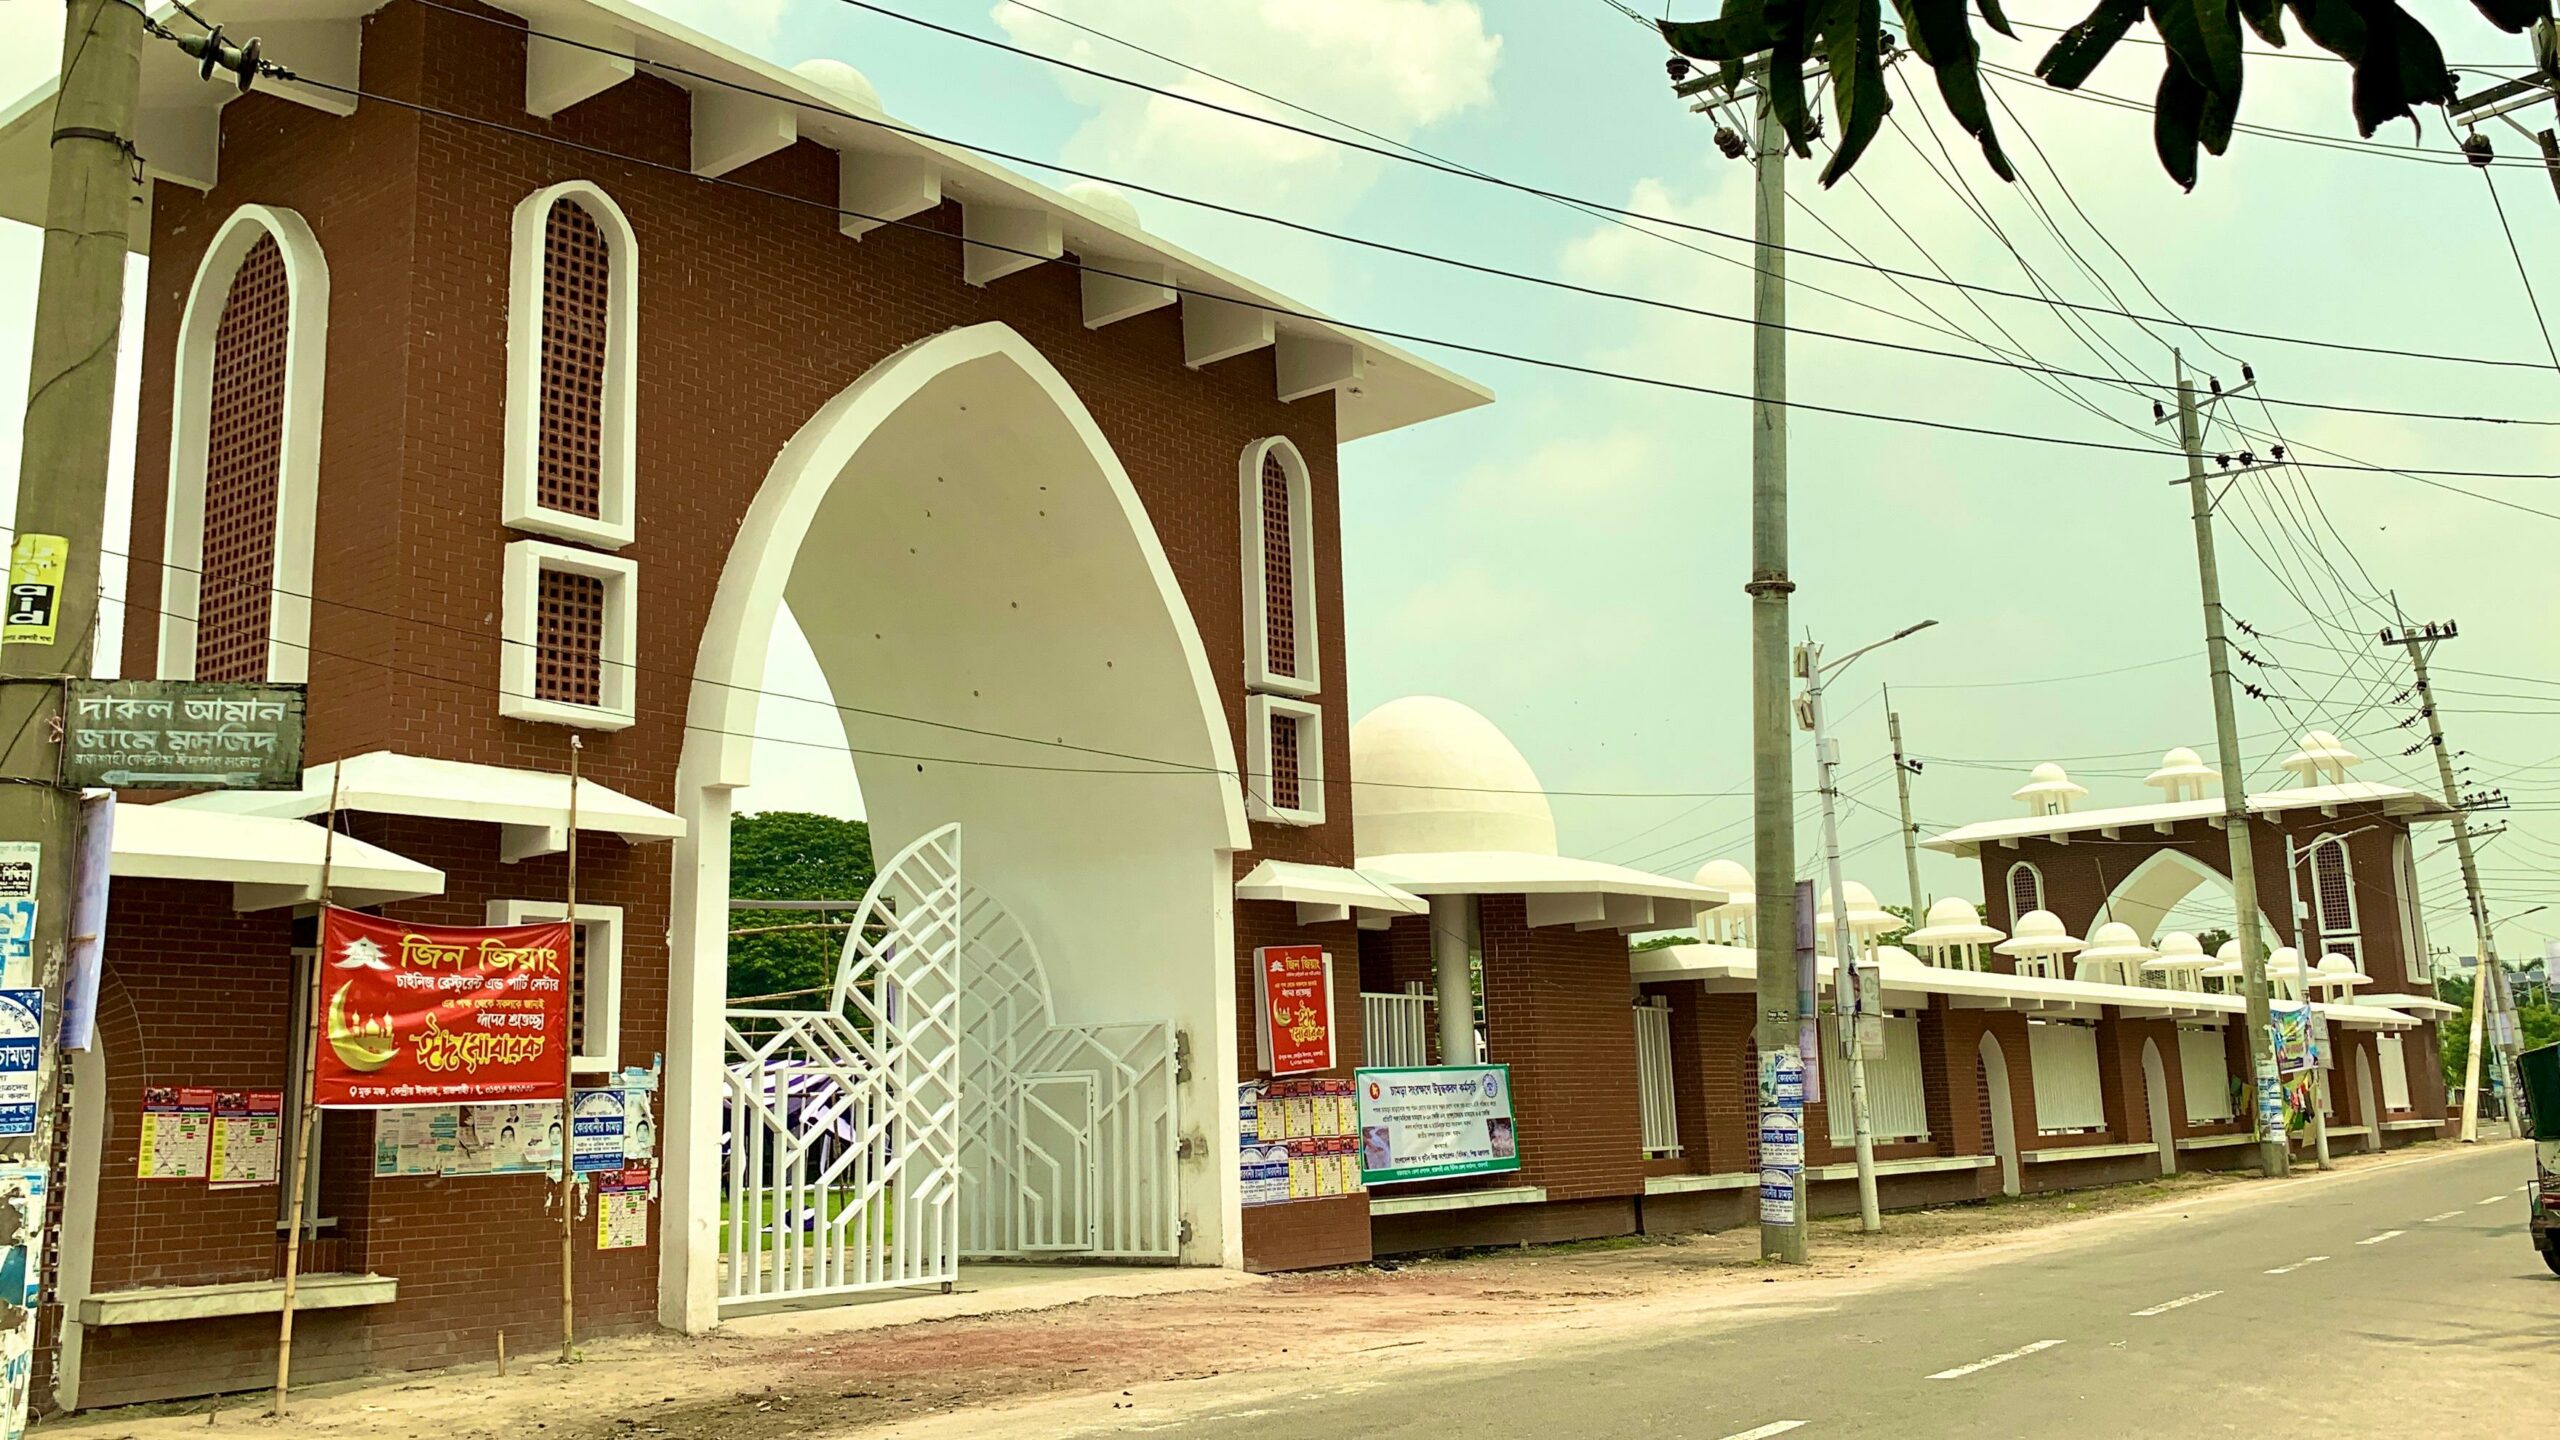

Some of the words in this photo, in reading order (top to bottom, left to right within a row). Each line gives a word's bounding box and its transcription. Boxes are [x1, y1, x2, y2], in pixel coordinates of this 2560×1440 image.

[77, 694, 174, 721] দারুল
[184, 697, 286, 722] আমান
[76, 727, 160, 750] জামে
[399, 933, 469, 970] জিন
[477, 937, 560, 974] জিয়াং
[395, 972, 435, 989] চাইনিজ
[506, 973, 530, 991] পার্টি
[530, 975, 559, 992] সেন্টার
